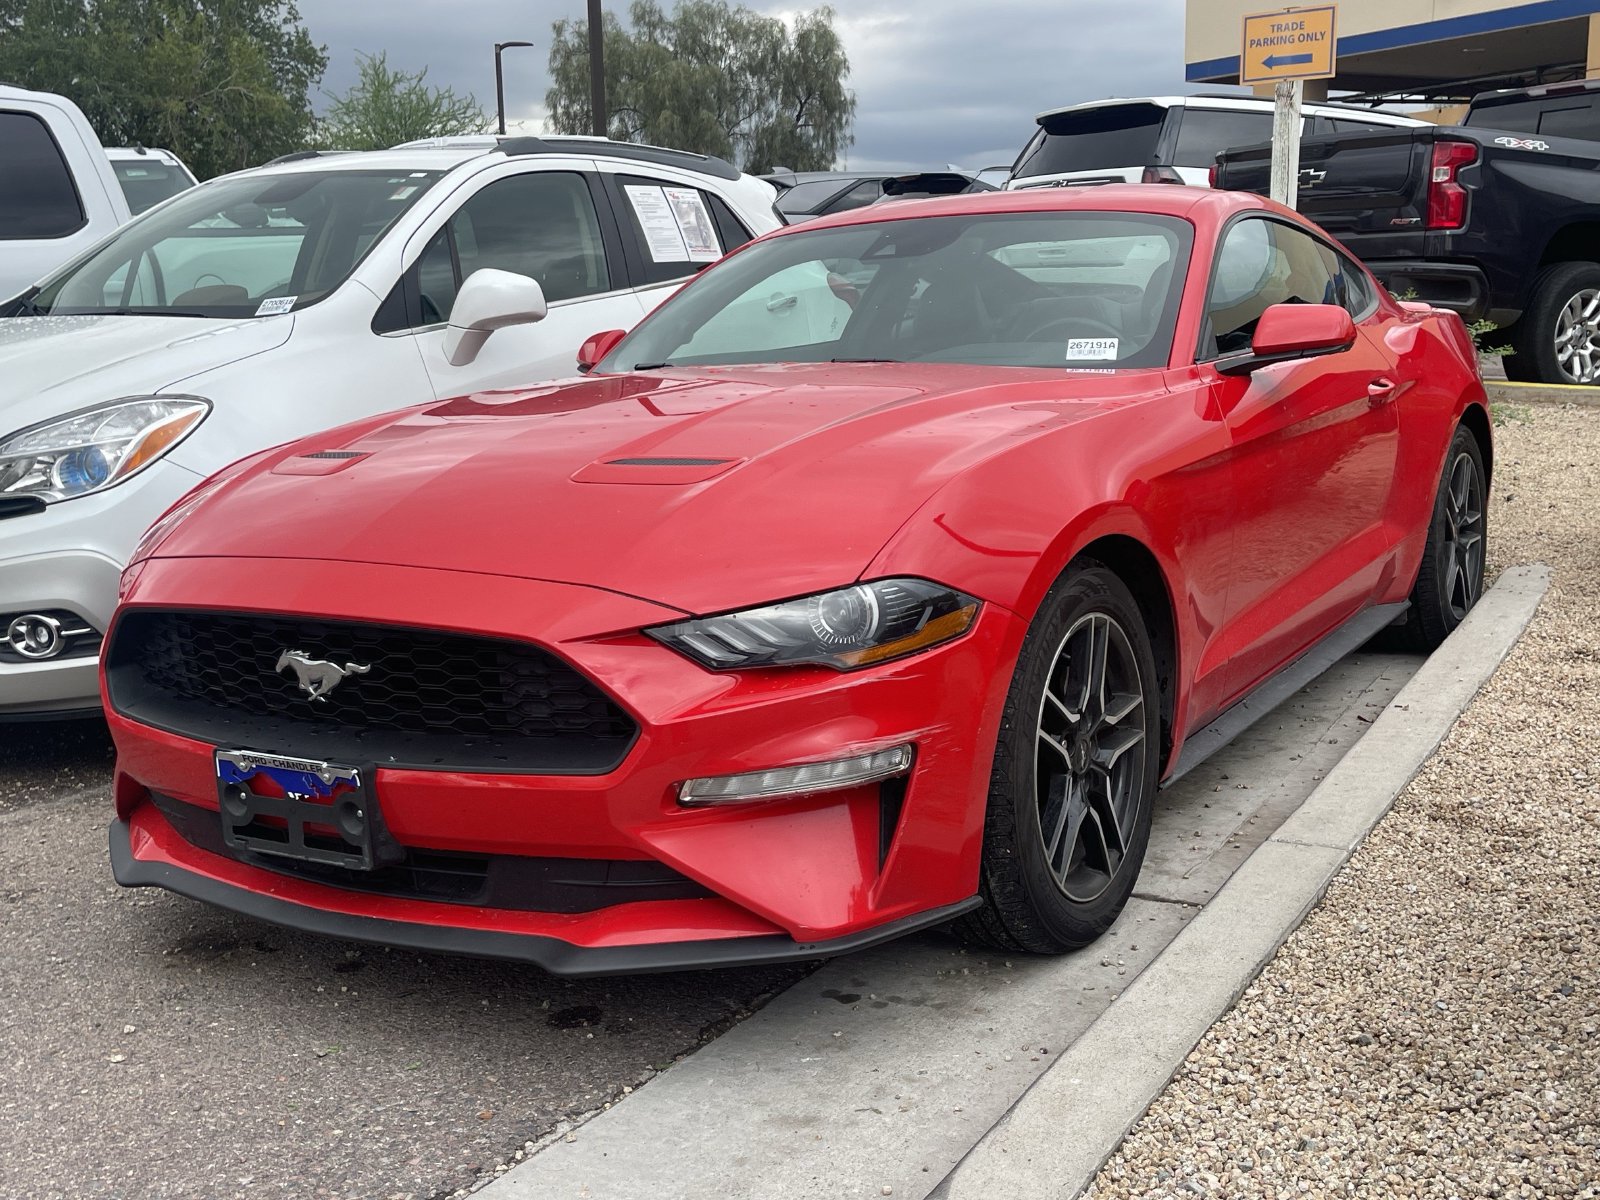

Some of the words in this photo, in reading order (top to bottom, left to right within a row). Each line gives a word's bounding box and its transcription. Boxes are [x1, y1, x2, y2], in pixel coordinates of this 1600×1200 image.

[1270, 21, 1305, 33] TRADE
[1249, 34, 1295, 48] PARKING
[1297, 31, 1326, 42] ONLY
[1069, 341, 1116, 350] 267191A
[241, 754, 267, 765] FORD
[274, 759, 322, 773] CHANDLER
